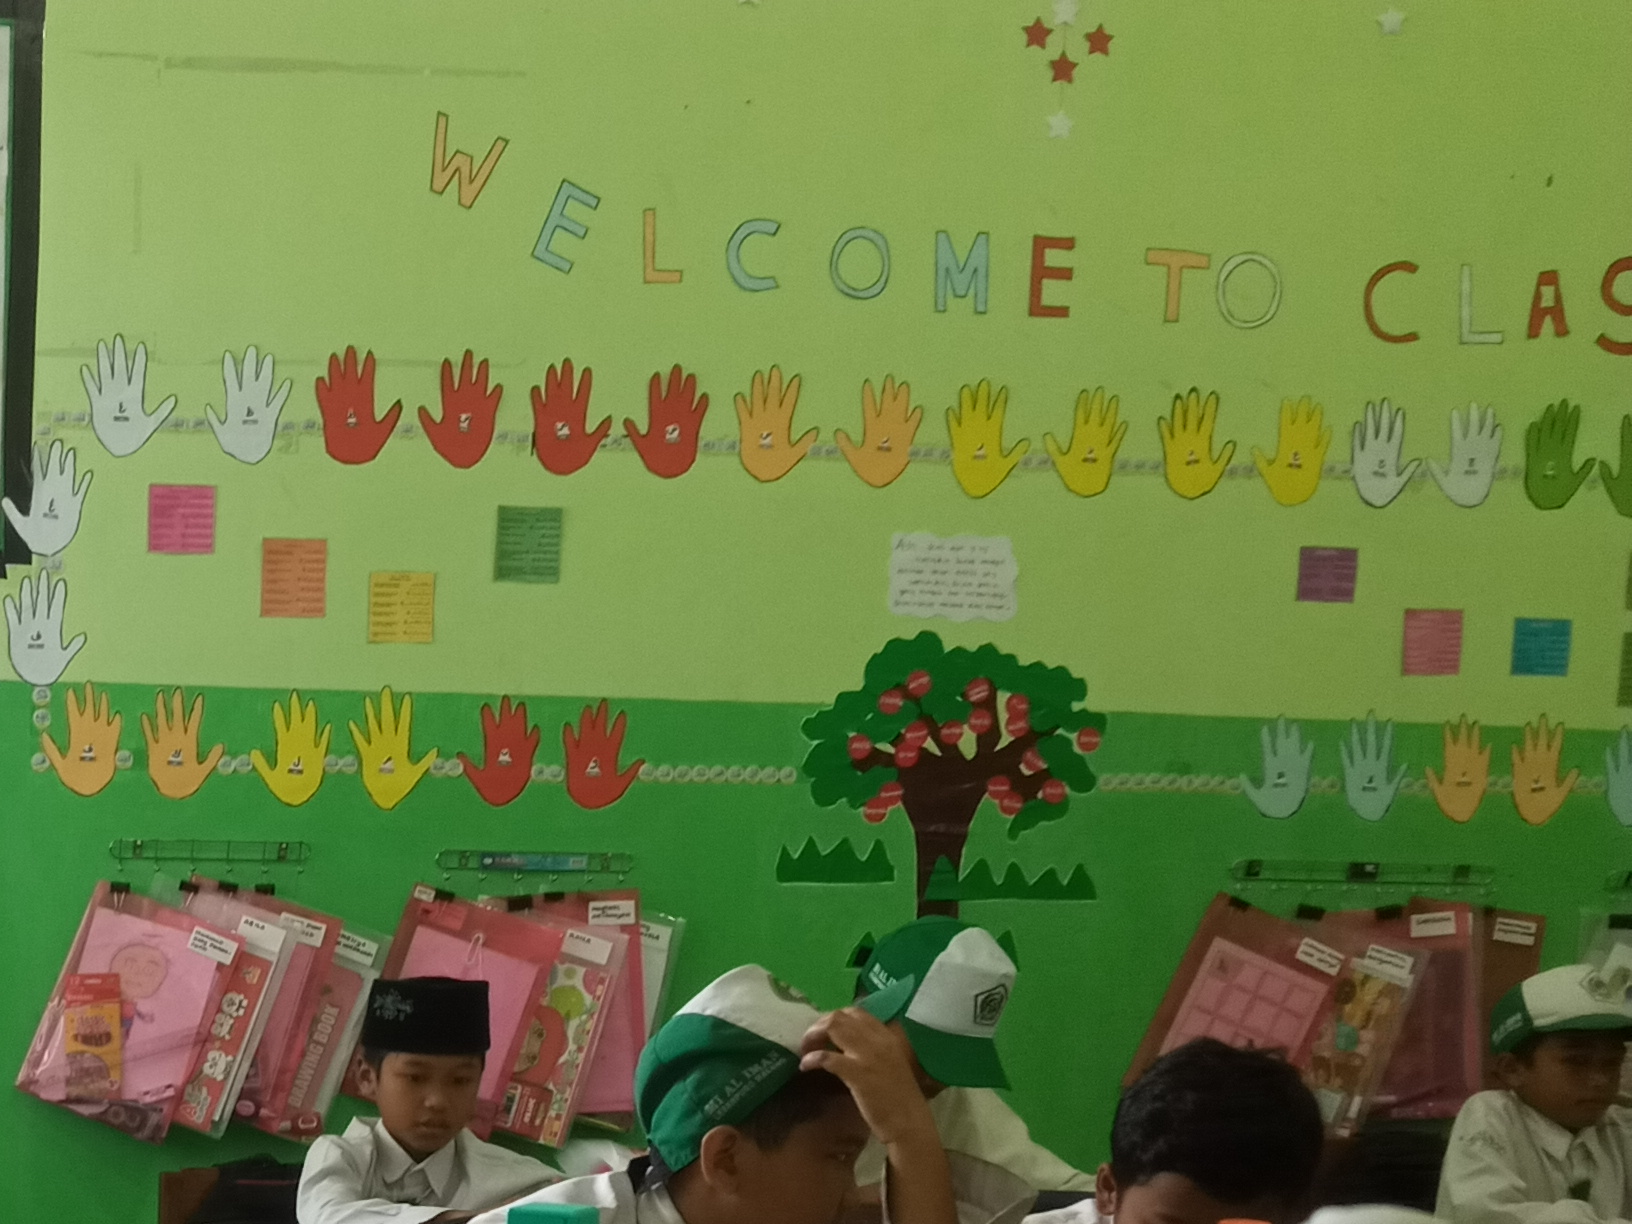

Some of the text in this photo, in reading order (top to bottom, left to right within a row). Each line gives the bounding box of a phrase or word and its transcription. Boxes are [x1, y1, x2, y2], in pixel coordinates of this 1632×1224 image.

[430, 111, 1076, 319] WELCOME
[1144, 247, 1282, 330] TO
[312, 1003, 340, 1045] BOOK
